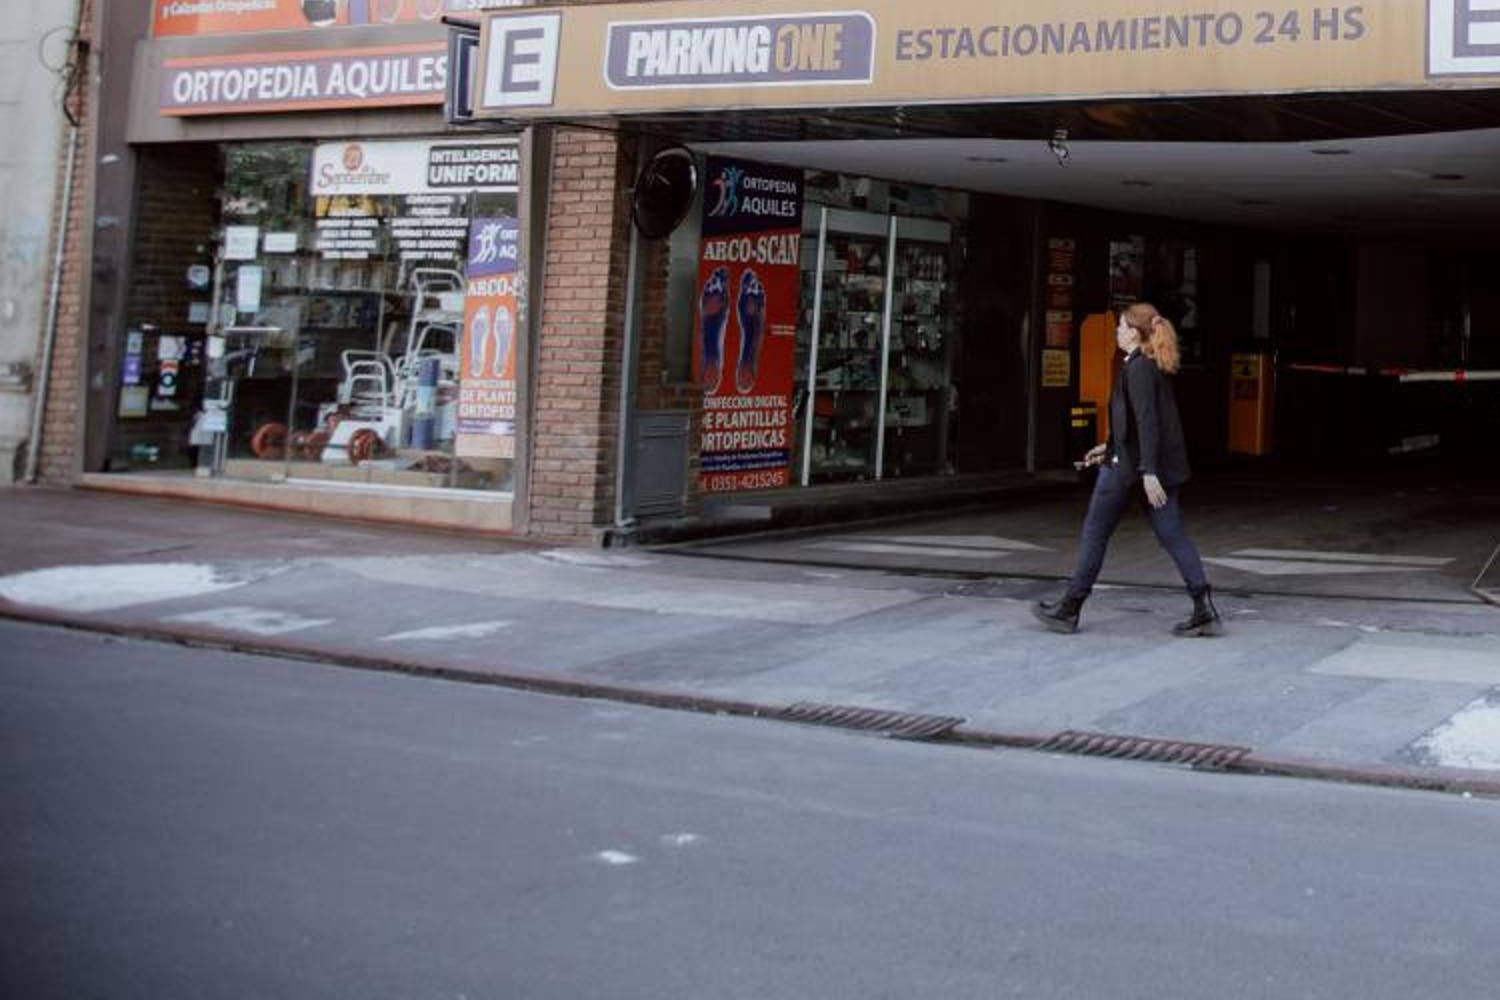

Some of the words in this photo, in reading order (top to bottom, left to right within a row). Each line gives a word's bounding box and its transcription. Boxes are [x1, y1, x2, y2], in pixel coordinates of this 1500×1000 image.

[895, 11, 1243, 61] ESTACIONAMIENTO
[1255, 10, 1301, 43] 24
[1312, 6, 1365, 42] HS
[500, 28, 544, 93] E
[626, 24, 771, 76] PARKING
[173, 65, 319, 103] ORTOPEDIA
[325, 56, 448, 97] AQUILES
[430, 148, 518, 163] INTELIGENCIA
[743, 177, 796, 195] ORTOPEDIA
[741, 196, 796, 217] AQUILES
[703, 234, 800, 265] ARCO-SCAN
[703, 396, 753, 409] ONFECCION
[702, 412, 714, 429] E
[715, 410, 787, 429] PLANTILLAS
[701, 429, 785, 452] RTOPEDICAS
